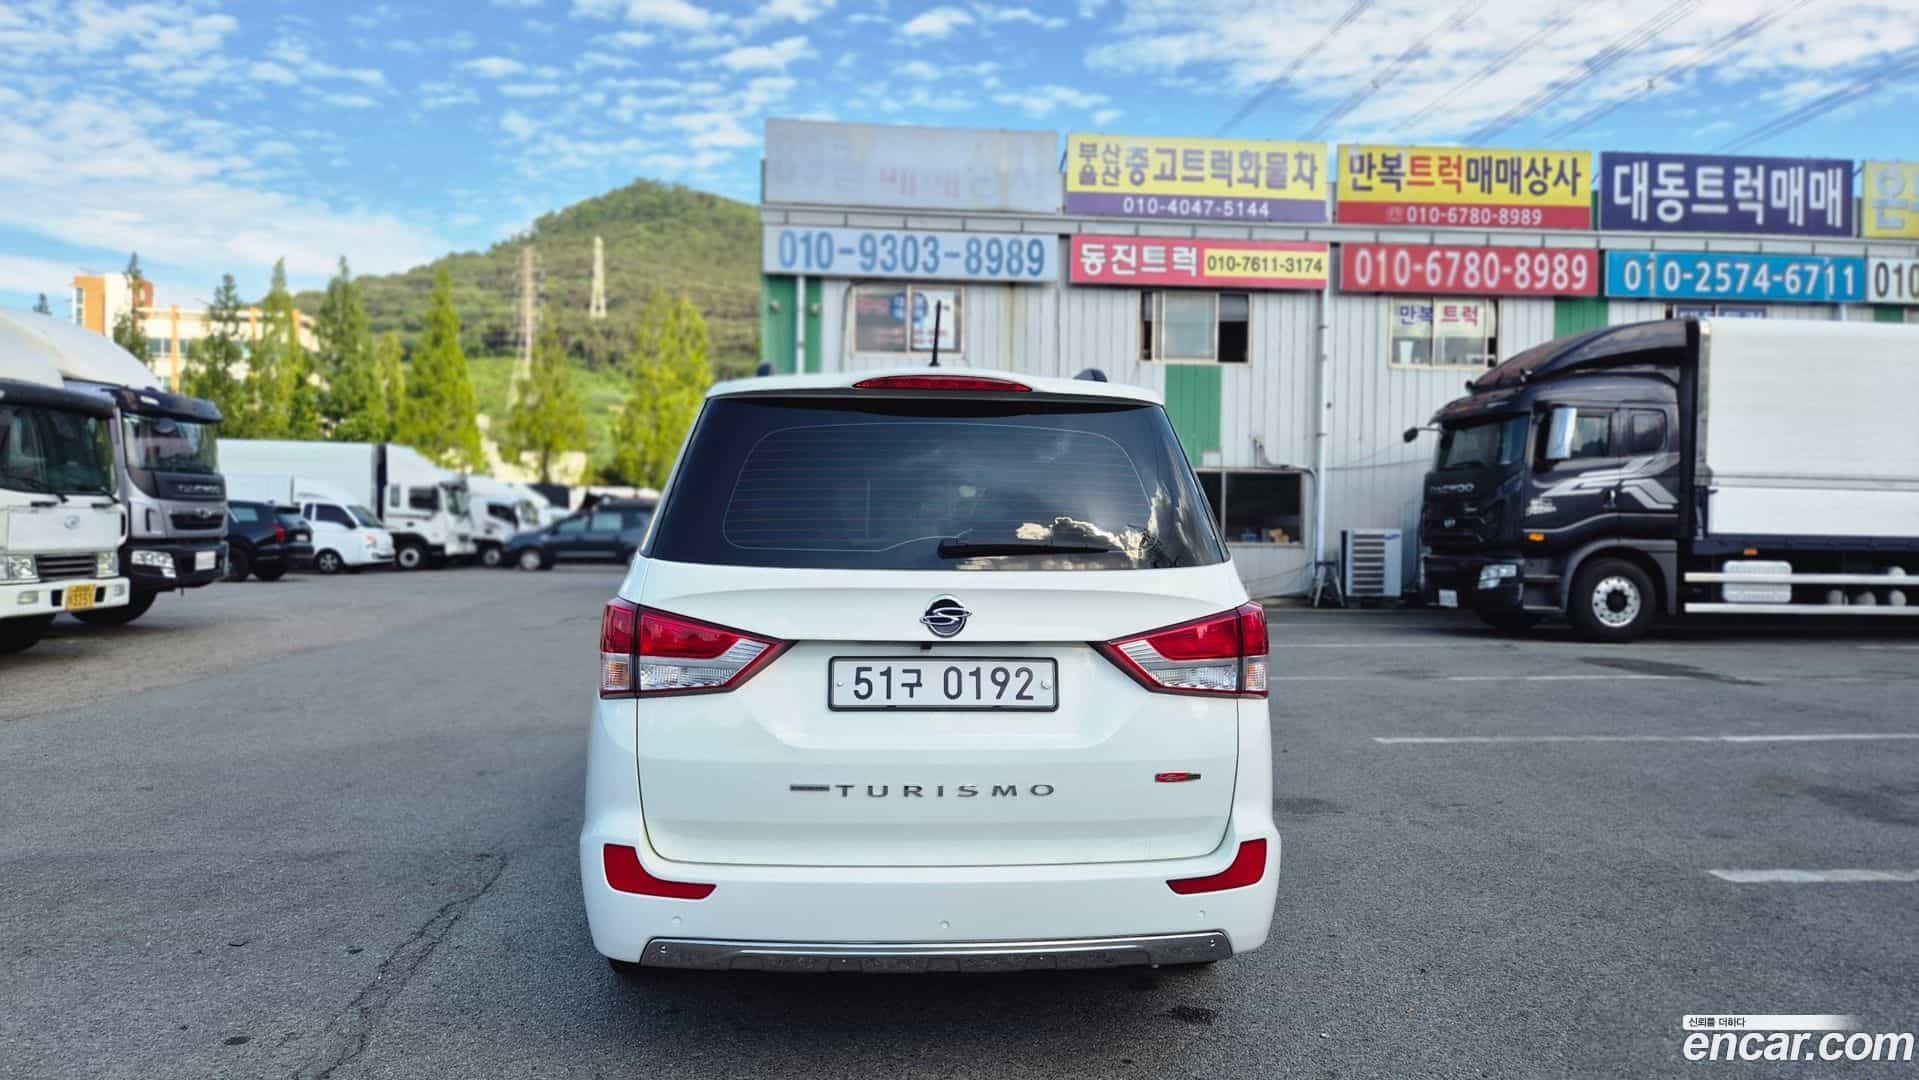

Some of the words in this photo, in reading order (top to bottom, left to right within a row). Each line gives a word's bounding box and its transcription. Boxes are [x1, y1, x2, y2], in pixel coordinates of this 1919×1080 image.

[1079, 142, 1121, 164] 부산
[1126, 145, 1318, 190] 중고트럭화물차
[1348, 152, 1582, 196] 만복트럭매매상사
[1123, 196, 1270, 218] 010-4047-5144
[1612, 161, 1843, 229] 대동트럭매매
[1406, 205, 1543, 225] 010-6780-8989
[777, 230, 1046, 278] 010-9303-8989
[1079, 242, 1198, 277] 동진트럭
[1206, 254, 1324, 275] 010-7611-3174
[1354, 251, 1590, 291] 010-6780-8989
[1623, 260, 1856, 297] 010-2574-6711
[1441, 304, 1479, 327] 트럭
[853, 666, 923, 700] 51구
[943, 666, 1034, 700] 0192
[833, 783, 1056, 798] TURISMO
